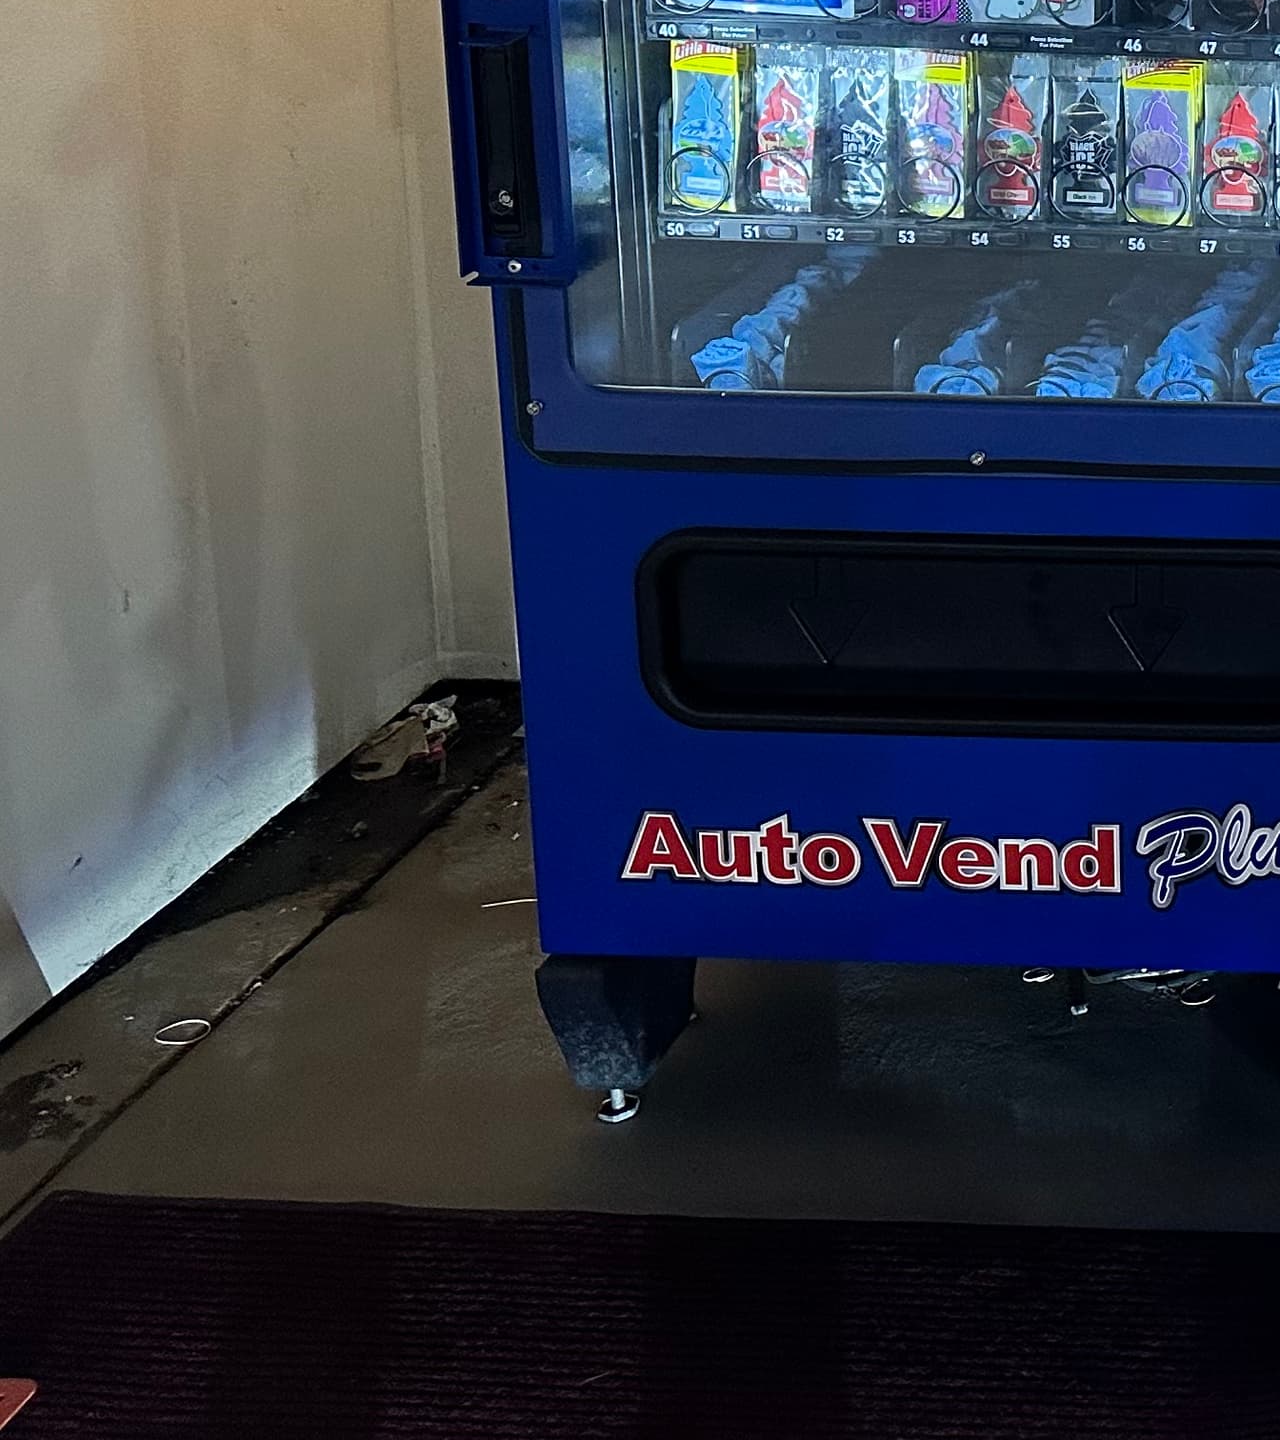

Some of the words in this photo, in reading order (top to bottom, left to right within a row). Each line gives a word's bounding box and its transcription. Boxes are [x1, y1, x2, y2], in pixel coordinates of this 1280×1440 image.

[658, 23, 678, 38] 40
[970, 33, 989, 47] 44
[1123, 38, 1142, 52] 46
[1199, 41, 1217, 55] 47
[1069, 141, 1095, 152] BLACK
[666, 222, 686, 236] 50
[743, 224, 760, 239] 51
[826, 227, 845, 242] 52
[898, 230, 916, 244] 53
[971, 232, 989, 246] 54
[1053, 234, 1071, 249] 55
[1128, 237, 1146, 251] 56
[1199, 239, 1218, 253] 57
[620, 810, 862, 886] Auto
[862, 817, 1123, 894] Vend
